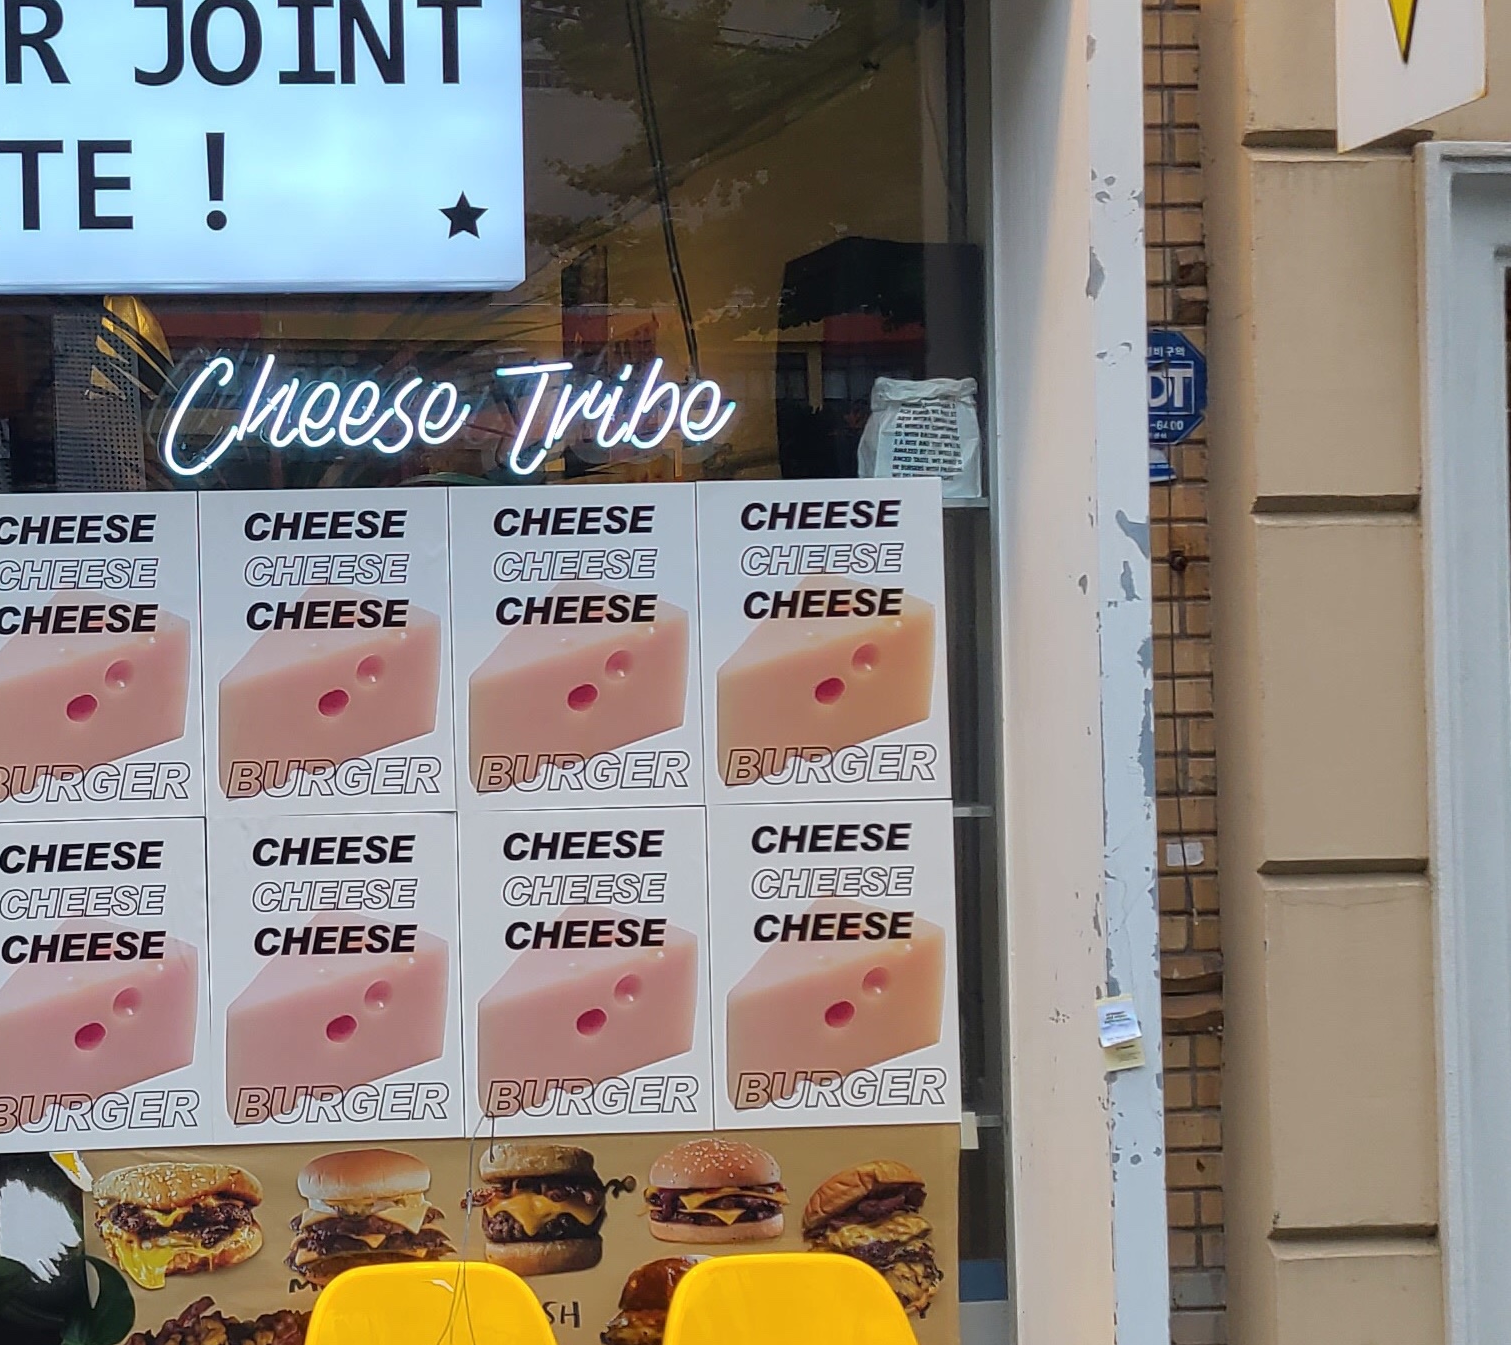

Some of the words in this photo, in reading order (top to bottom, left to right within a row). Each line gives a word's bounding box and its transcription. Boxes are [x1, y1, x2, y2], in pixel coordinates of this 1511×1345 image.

[163, 354, 471, 476] Cheese
[496, 357, 737, 475] Tribe
[244, 510, 407, 541] CHEESE
[493, 506, 656, 537] CHEESE
[740, 499, 901, 531] CHEESE
[244, 554, 409, 587] CHEESE
[493, 547, 657, 582] CHEESE
[741, 542, 904, 576] CHEESE
[245, 599, 409, 631] CHEESE
[495, 594, 658, 626] CHEESE
[743, 587, 904, 620] CHEESE
[226, 756, 441, 800] BURGER
[476, 750, 690, 794] BURGER
[724, 743, 936, 787] BURGER
[252, 834, 416, 866] CHEESE
[502, 829, 665, 862] CHEESE
[750, 822, 913, 855] CHEESE
[251, 878, 417, 913] CHEESE
[502, 872, 667, 907] CHEESE
[750, 865, 915, 900] CHEESE
[253, 923, 417, 957] CHEESE
[504, 918, 667, 950] CHEESE
[753, 911, 915, 943] CHEESE
[0, 930, 166, 964] CHEESE
[233, 1082, 450, 1127] BURGER
[486, 1074, 699, 1118] BURGER
[733, 1067, 948, 1112] BURGER
